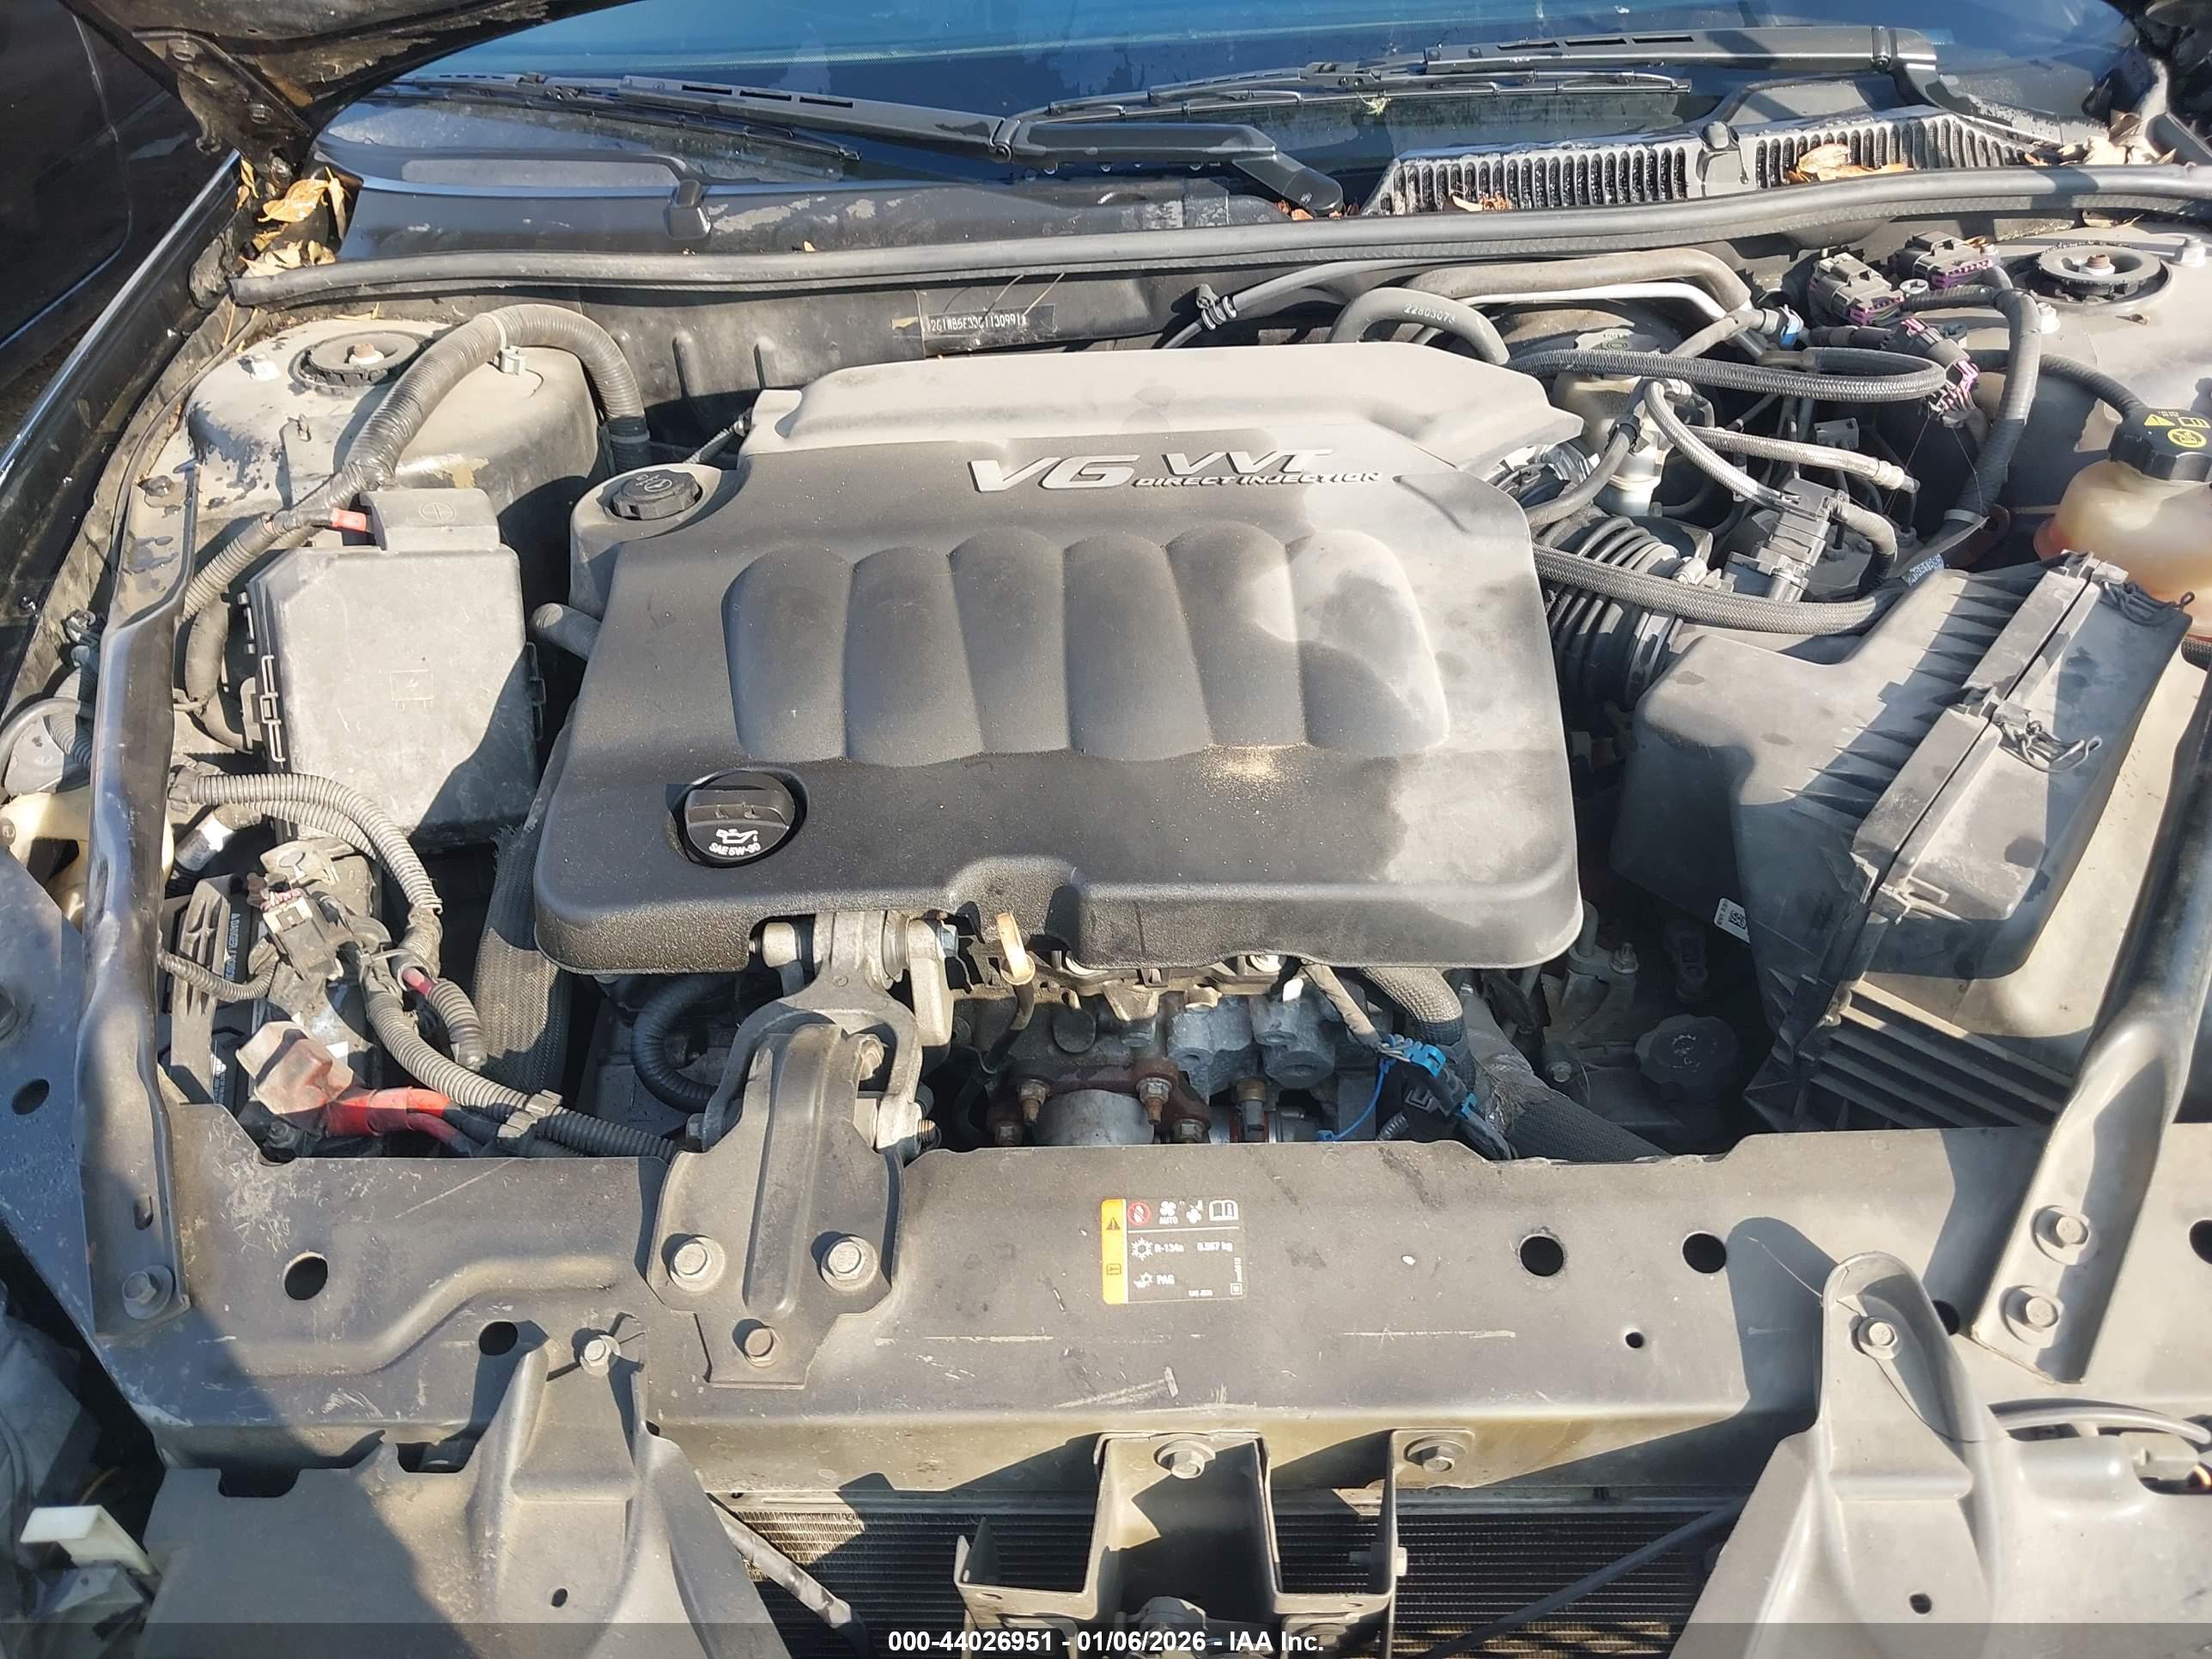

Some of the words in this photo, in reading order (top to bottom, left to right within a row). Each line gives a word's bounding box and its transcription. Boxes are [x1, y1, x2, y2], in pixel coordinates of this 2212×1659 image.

[968, 454, 1140, 492] V6
[1161, 448, 1334, 475] VVT
[1132, 475, 1237, 487] DIRECT
[1238, 471, 1382, 485] INJECTION
[708, 842, 729, 855] SAE
[728, 842, 761, 856] 5W-30
[1159, 1216, 1178, 1224] AUTO
[1154, 1243, 1184, 1253] R-134a
